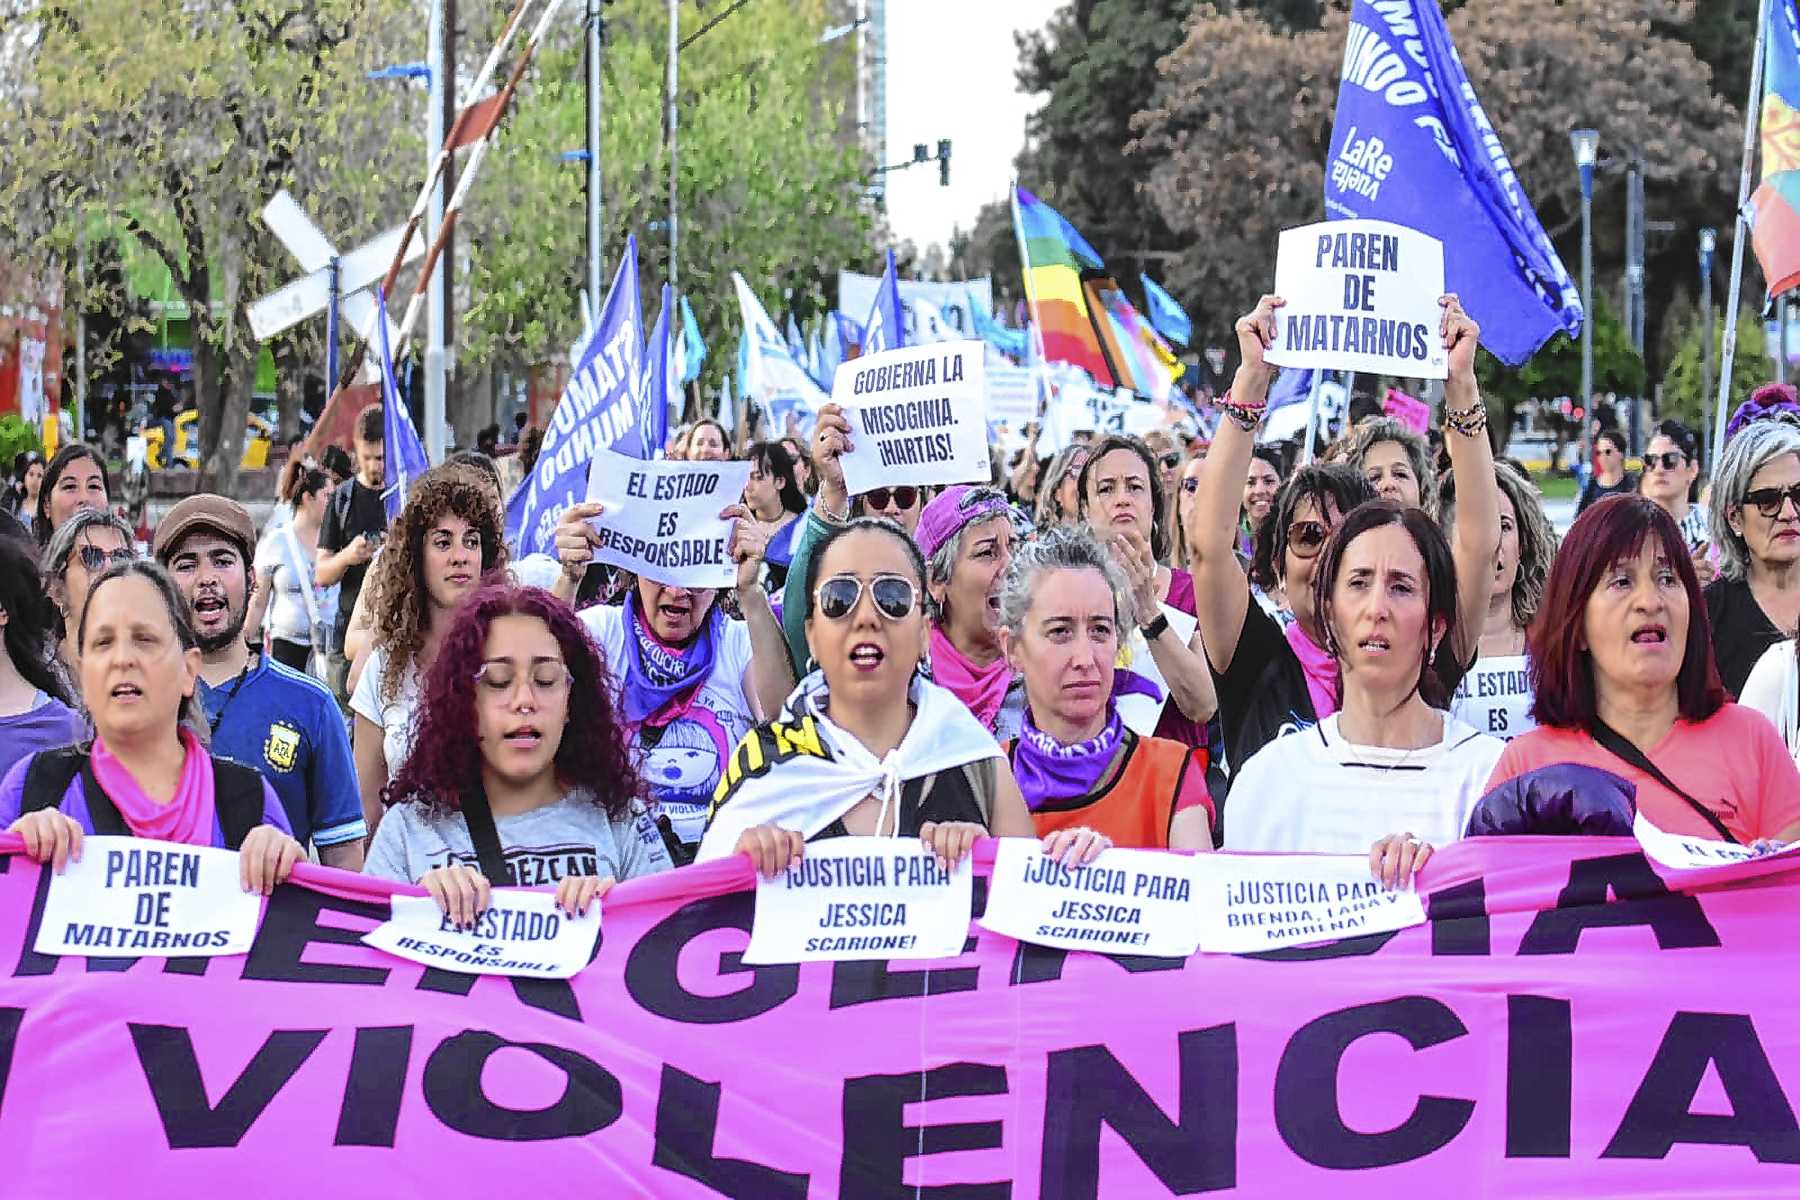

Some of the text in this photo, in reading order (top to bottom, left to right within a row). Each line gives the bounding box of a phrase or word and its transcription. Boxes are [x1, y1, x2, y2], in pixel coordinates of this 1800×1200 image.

[1316, 233, 1399, 272] PAREN
[1343, 274, 1376, 311] DE
[1286, 315, 1428, 361] MATARNOS
[854, 354, 963, 396] GOBIERNA LA
[860, 398, 959, 435] MISOGINIA.
[877, 433, 955, 467] ¡HARTAS!
[626, 472, 719, 500] EL ESTADO
[657, 512, 678, 537] ES
[600, 527, 724, 568] RESPONSABLE
[1488, 708, 1508, 732] ES
[105, 850, 201, 889] PAREN
[1024, 856, 1191, 902] ¡JUSTICIA PARA
[134, 892, 172, 927] DE
[1226, 880, 1330, 907] ¡JUSTICIA
[472, 908, 560, 941] ESTADO
[819, 903, 907, 928] JESSICA
[1052, 900, 1142, 924] JESSICA
[1227, 910, 1322, 928] BRENDA,
[1266, 915, 1368, 940] MORENA!
[63, 923, 231, 949] MATARNOS
[473, 944, 504, 956] ES
[805, 935, 918, 952] SCARIONE!
[1036, 925, 1151, 946] SCARIONE!
[396, 937, 560, 972] RESPONSABLE
[128, 993, 1800, 1200] VIOLENCIA
